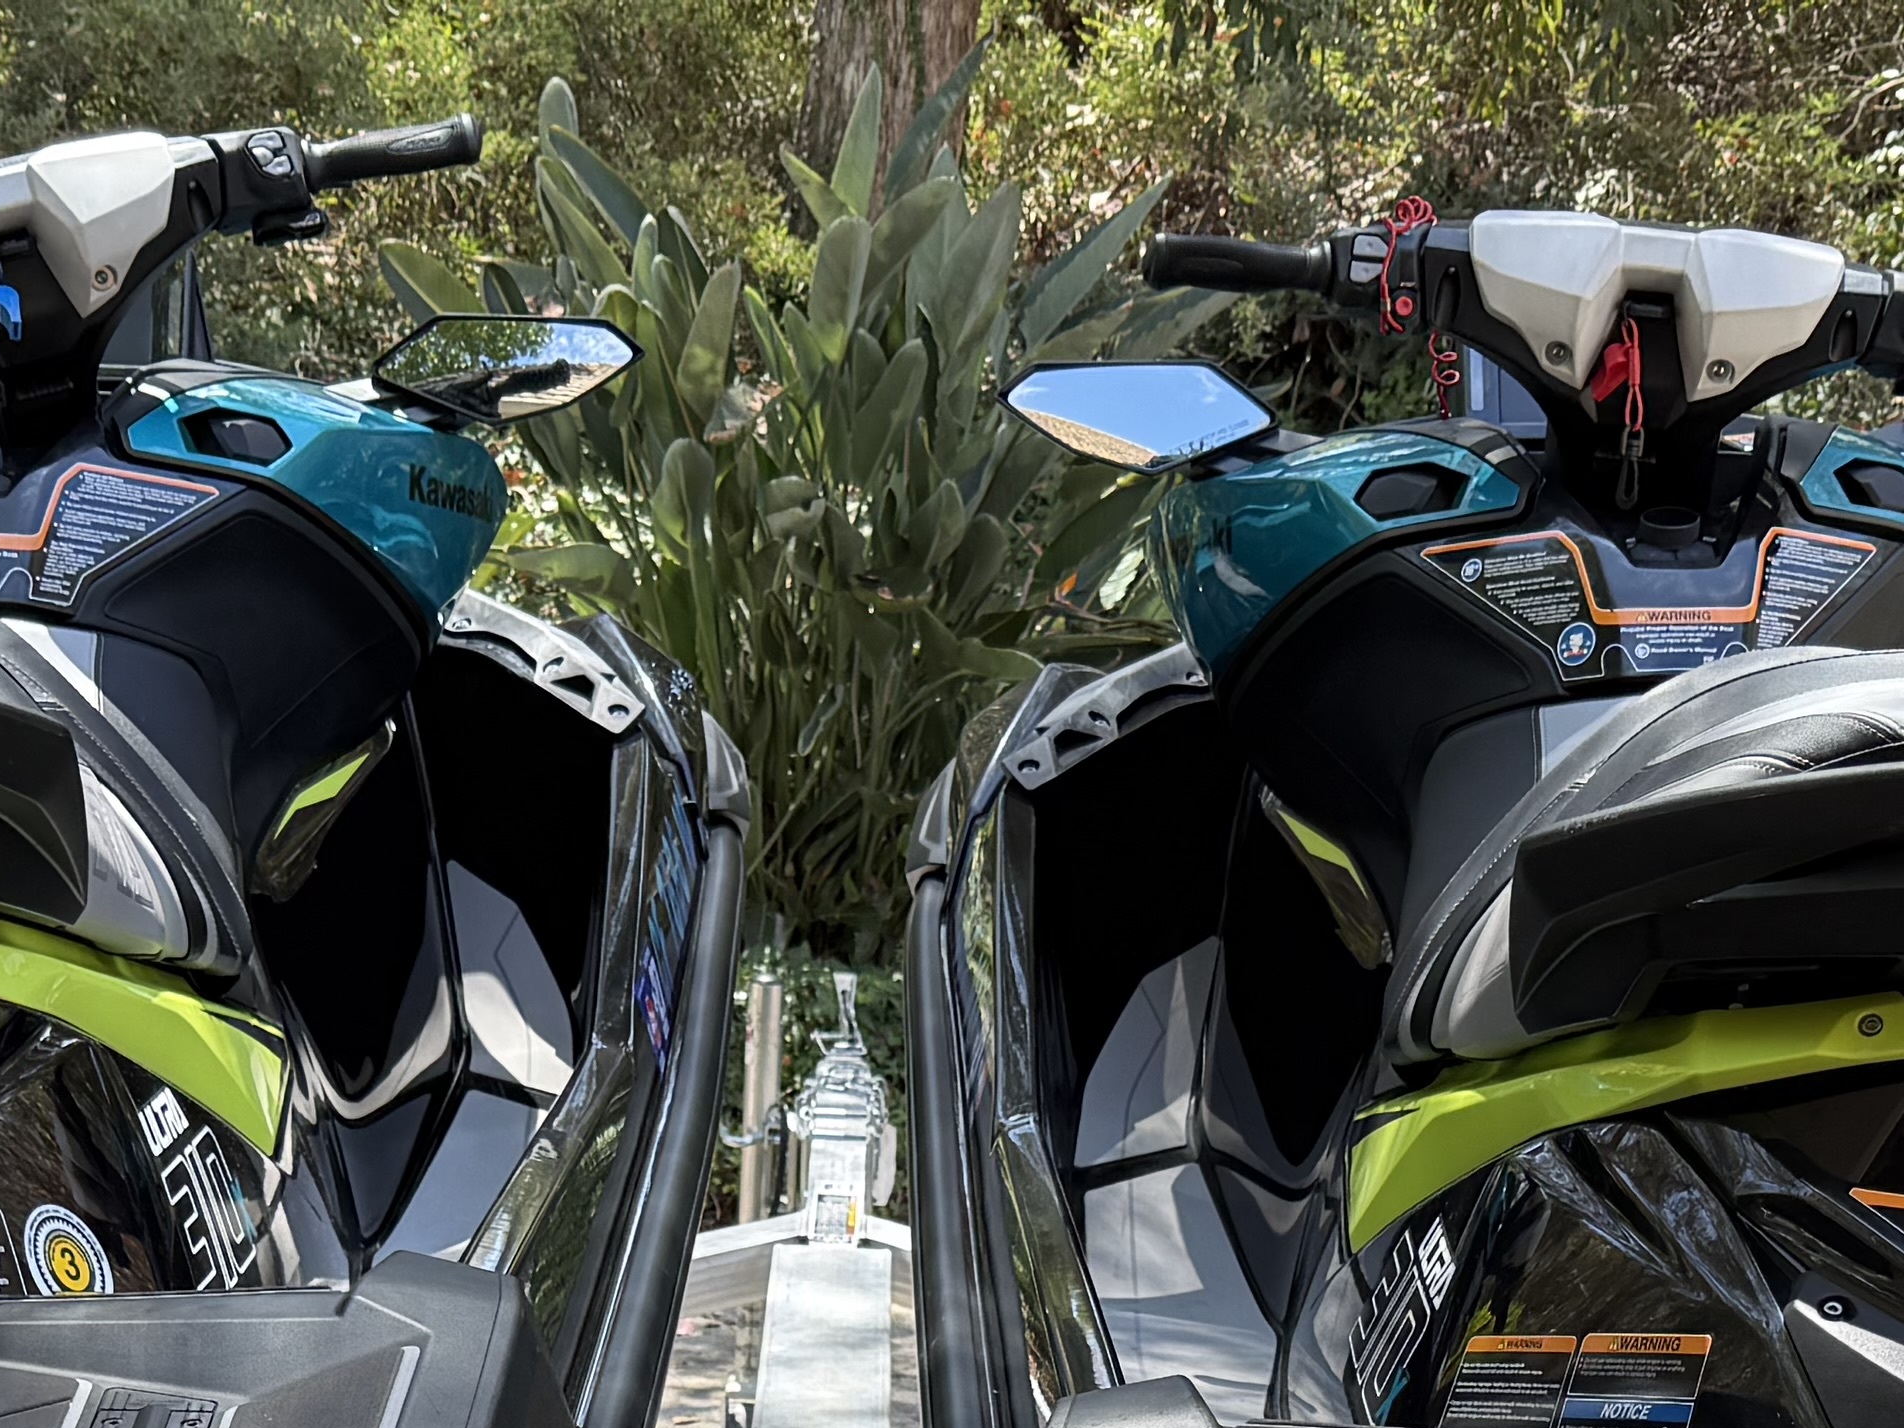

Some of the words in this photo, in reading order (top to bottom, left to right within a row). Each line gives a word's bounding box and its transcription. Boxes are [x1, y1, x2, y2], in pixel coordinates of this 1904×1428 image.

[1648, 610, 1711, 621] WARNING
[138, 1086, 190, 1157] ULTRA
[61, 1247, 81, 1281] 3
[1619, 1337, 1681, 1351] WARNING
[1600, 1403, 1652, 1420] NOTICE
